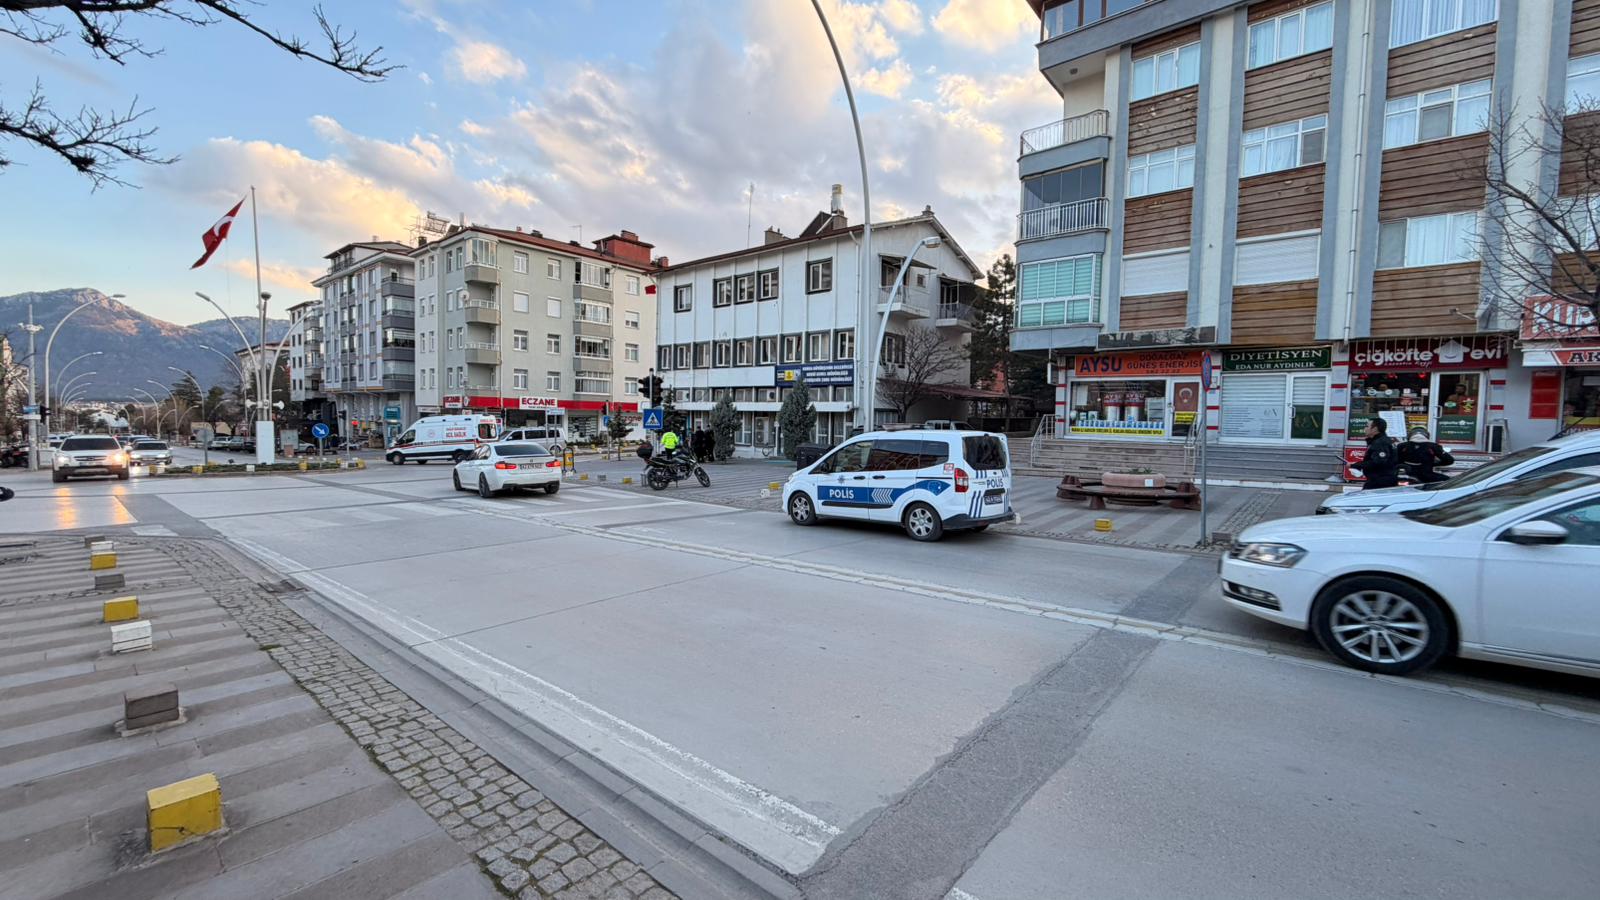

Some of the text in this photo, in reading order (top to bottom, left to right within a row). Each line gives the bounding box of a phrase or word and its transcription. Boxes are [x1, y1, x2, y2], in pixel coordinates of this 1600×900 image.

[1230, 349, 1323, 361] DİYETİSYEN
[1354, 345, 1501, 367] çiğköfte evi
[1080, 355, 1122, 373] AYSU
[1253, 362, 1272, 370] NUR
[1273, 361, 1316, 369] AYDINLIK
[521, 397, 556, 406] ECZANE
[986, 478, 1004, 489] POLİS
[829, 488, 854, 499] POLİS
